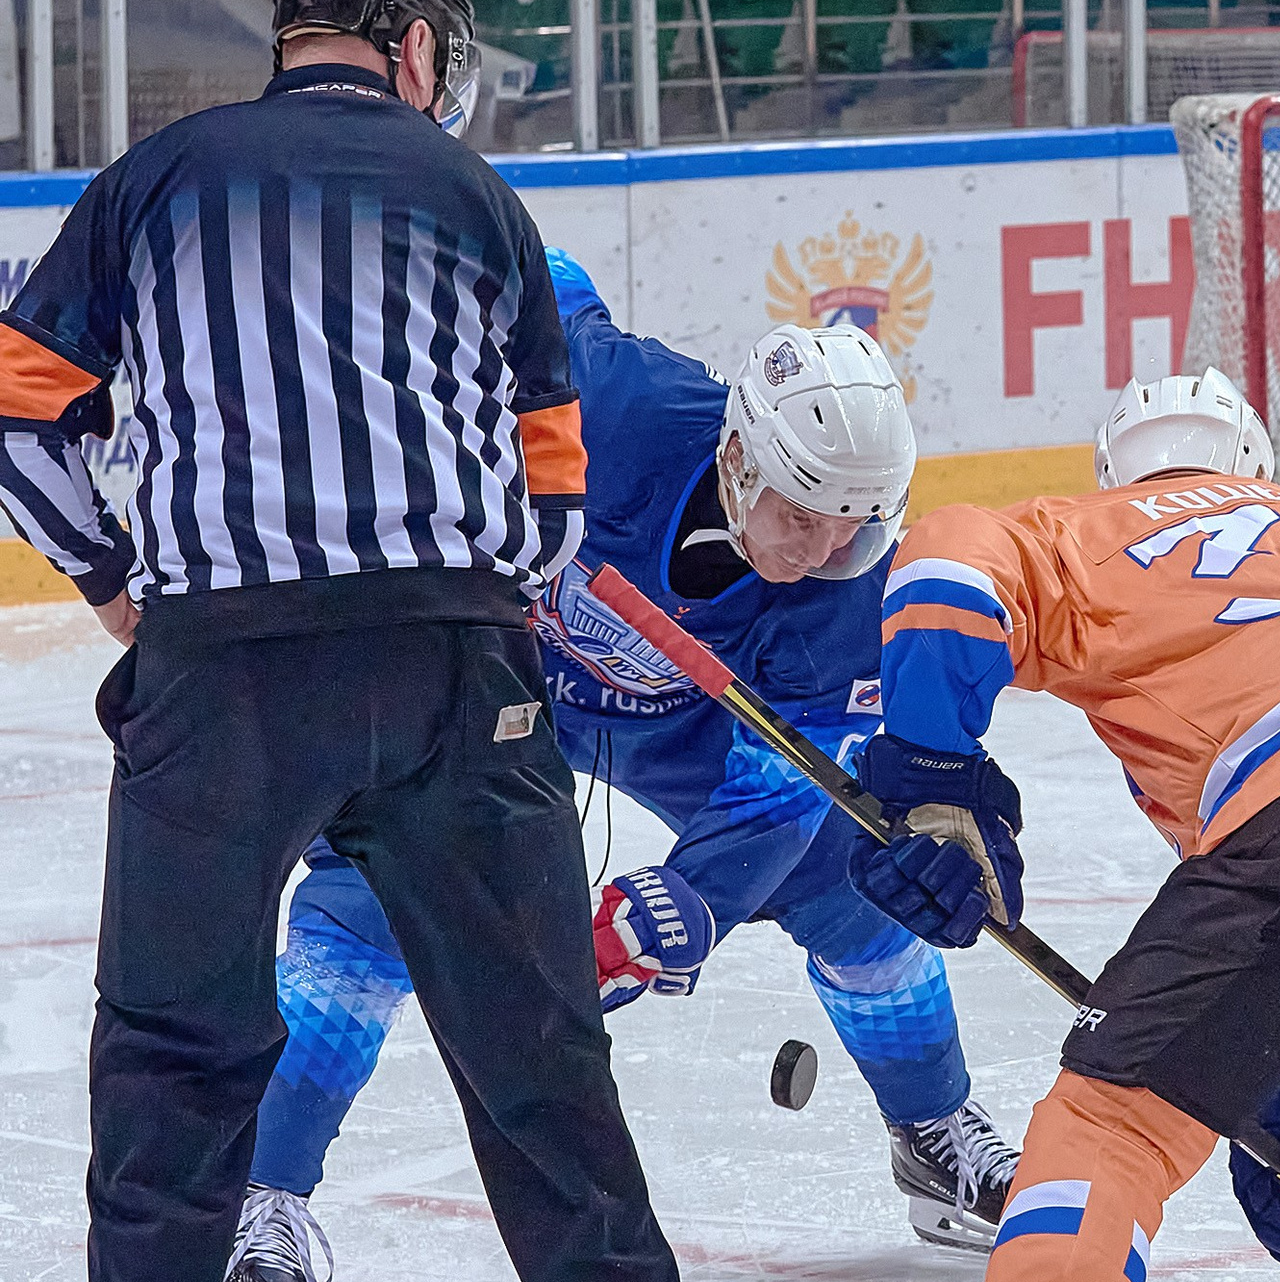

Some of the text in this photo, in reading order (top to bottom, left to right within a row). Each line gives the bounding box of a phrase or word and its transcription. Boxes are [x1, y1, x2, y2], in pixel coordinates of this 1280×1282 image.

[737, 384, 756, 425] BAUER
[911, 756, 965, 770] BAUER
[929, 1180, 956, 1198] BAU
